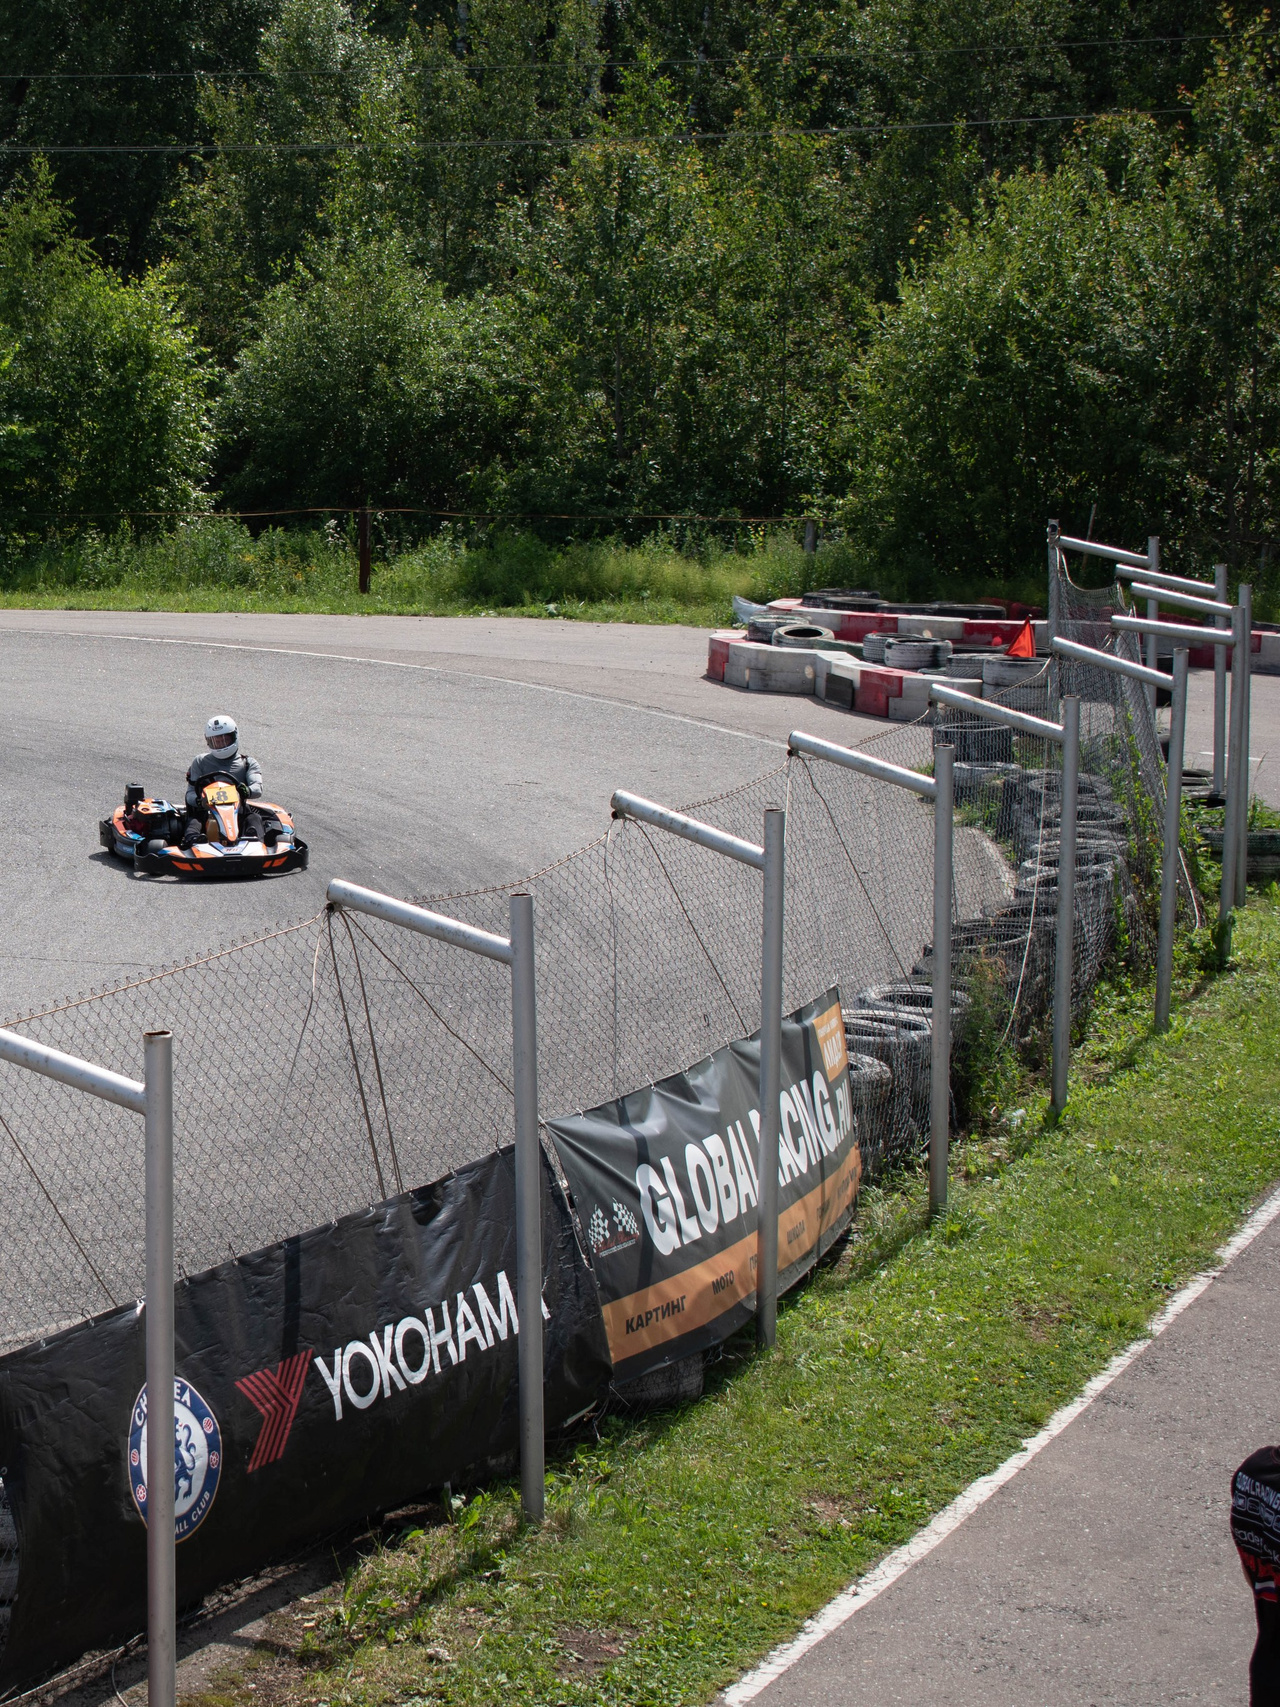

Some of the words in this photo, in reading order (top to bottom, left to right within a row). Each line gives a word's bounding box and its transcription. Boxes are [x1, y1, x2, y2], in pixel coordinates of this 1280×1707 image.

[711, 1270, 735, 1295] МОТО
[625, 1294, 687, 1335] КАРТИНГ
[314, 1270, 551, 1421] YOKOHAM
[135, 1382, 192, 1427] CHEA
[191, 1490, 211, 1522] CLUB
